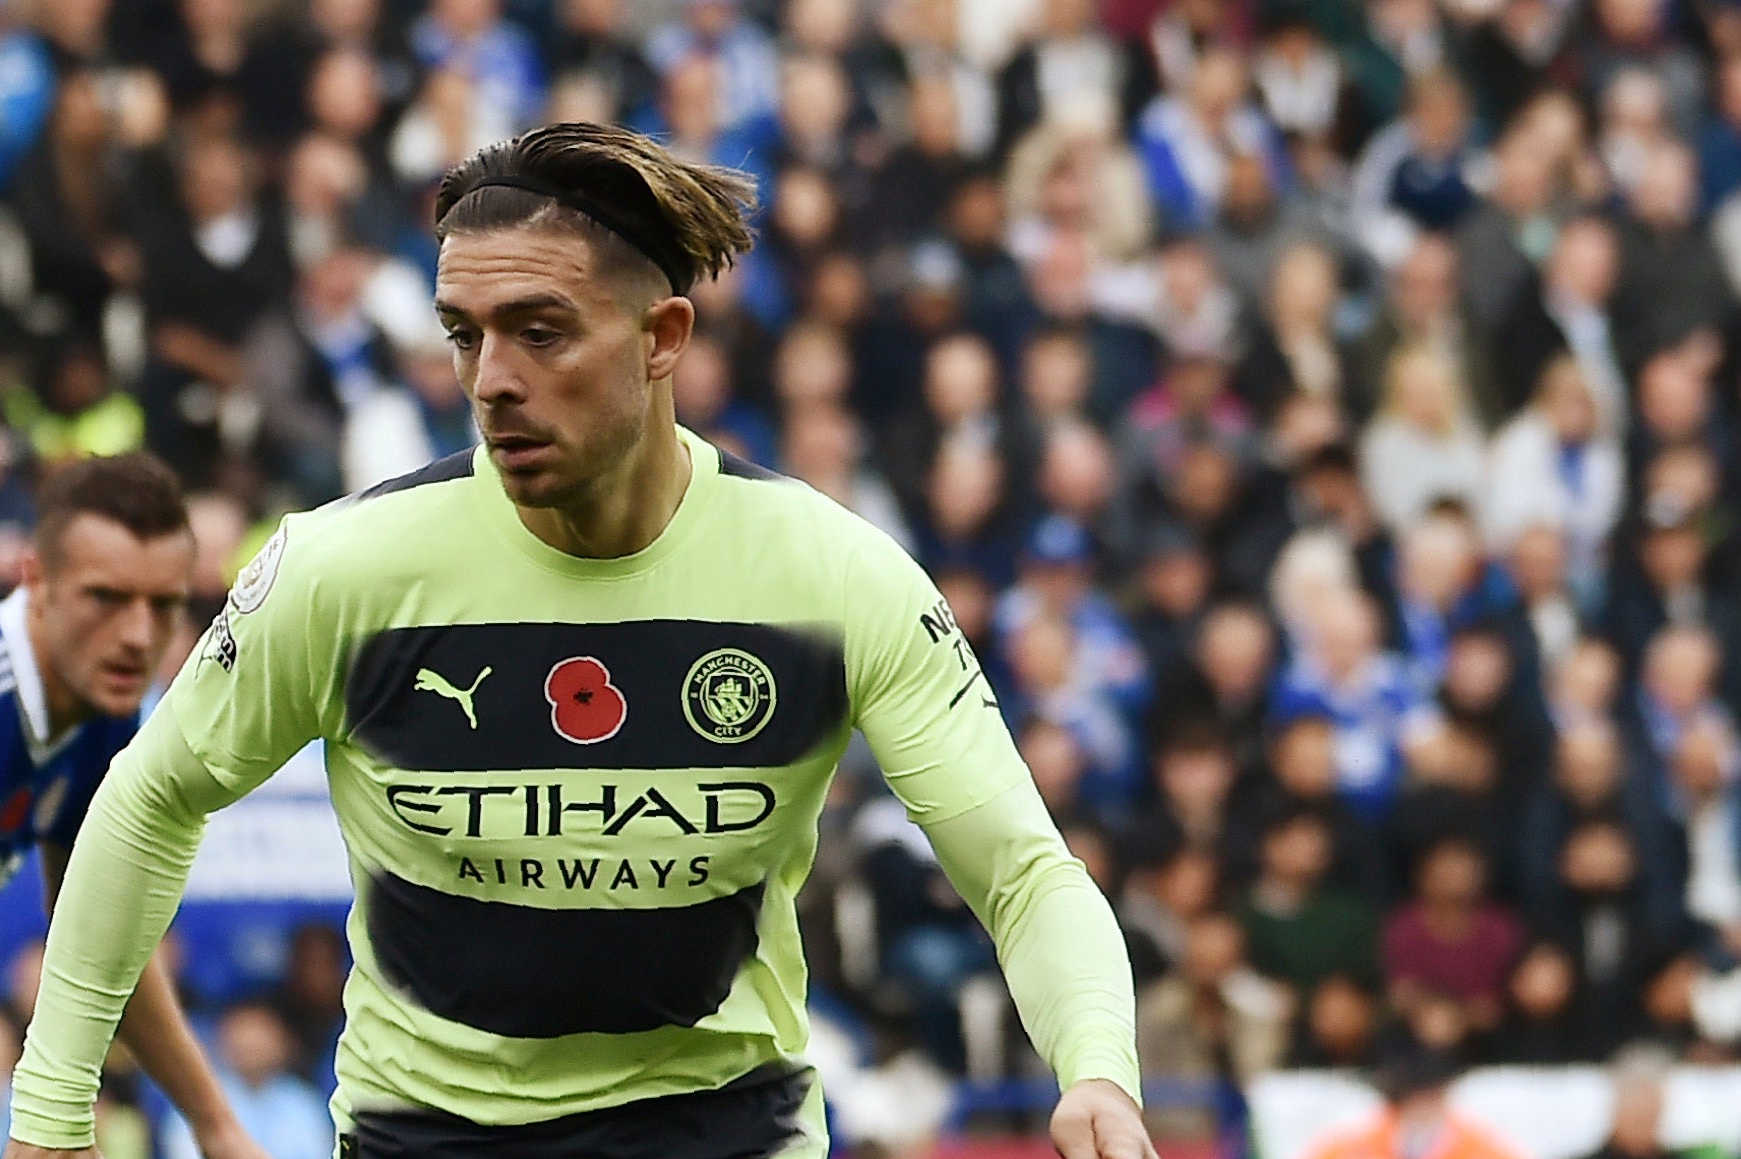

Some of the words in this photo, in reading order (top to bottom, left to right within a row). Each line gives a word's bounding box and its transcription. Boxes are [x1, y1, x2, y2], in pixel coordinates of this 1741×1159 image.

[694, 656, 766, 685] MANCHESTER
[714, 726, 742, 736] CITY
[386, 782, 776, 837] ETIHAD
[459, 856, 709, 889] AIRWAYS
